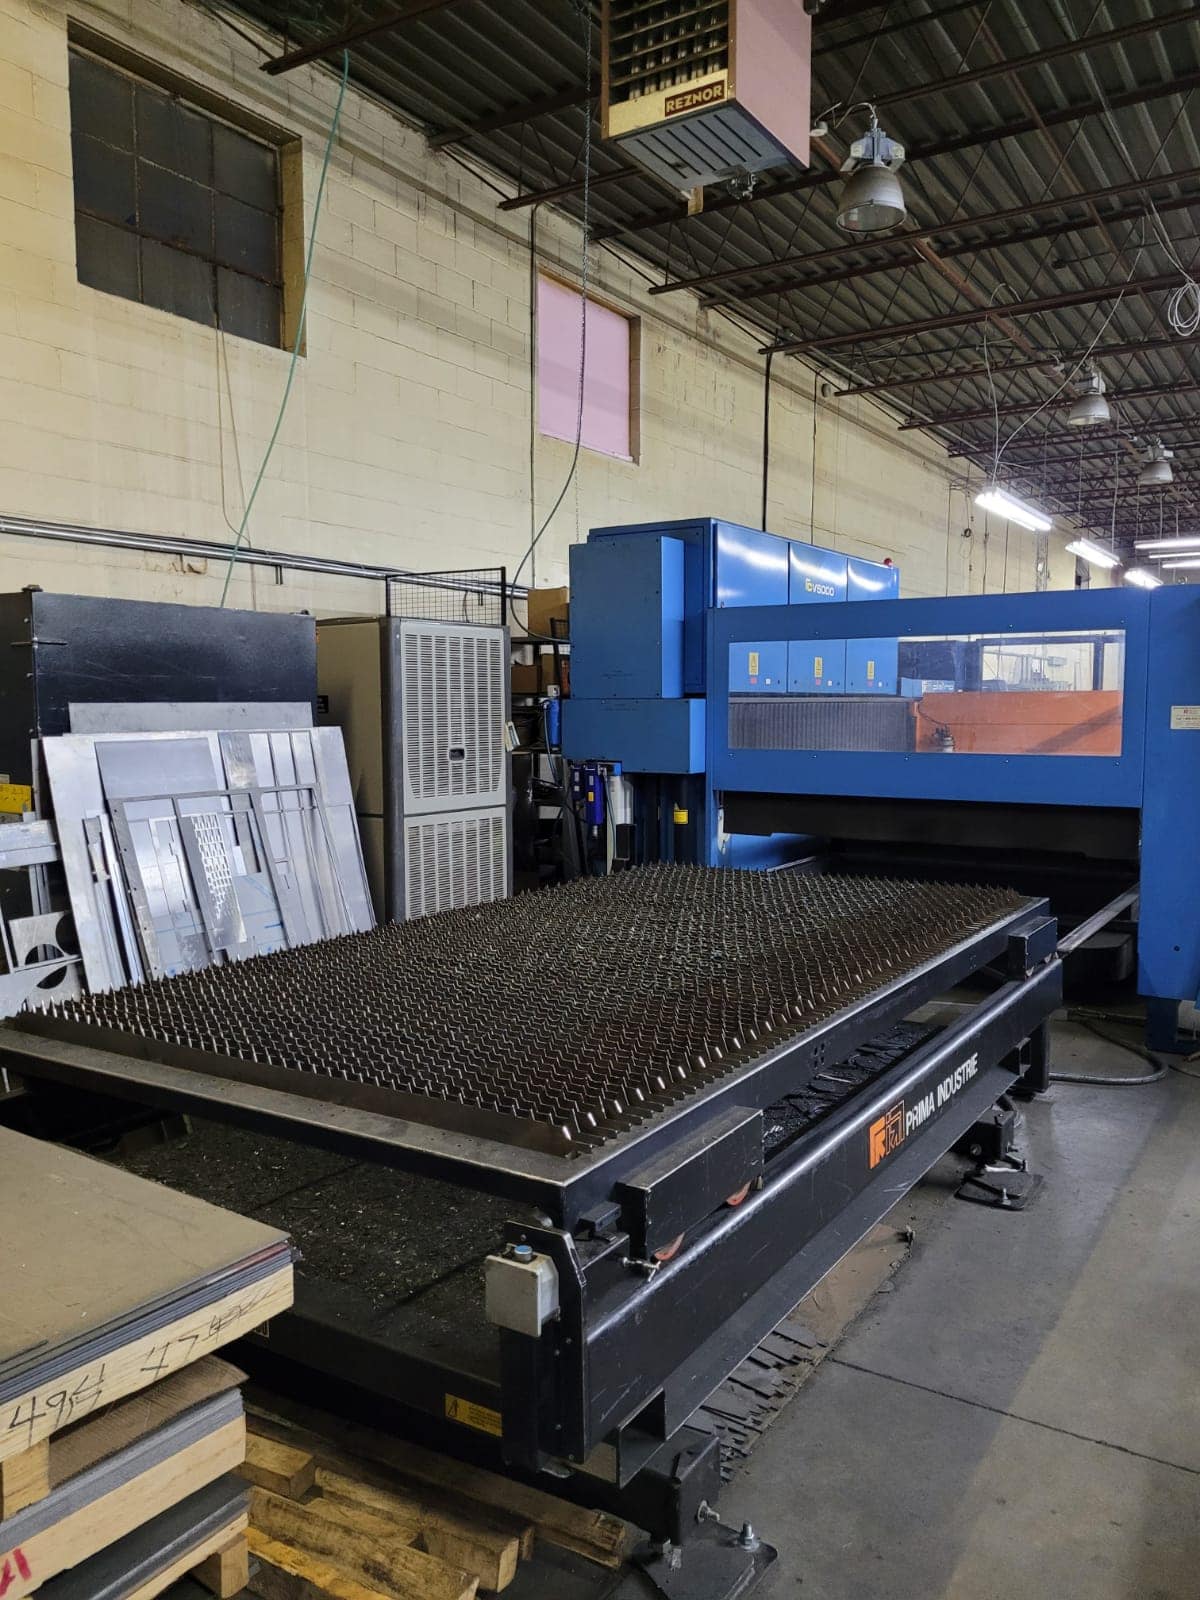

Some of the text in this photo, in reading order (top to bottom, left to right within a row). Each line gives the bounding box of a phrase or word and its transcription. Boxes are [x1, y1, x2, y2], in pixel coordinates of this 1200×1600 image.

[665, 84, 723, 114] REZNOR
[905, 1052, 979, 1137] PRIMA INDUSTRIE
